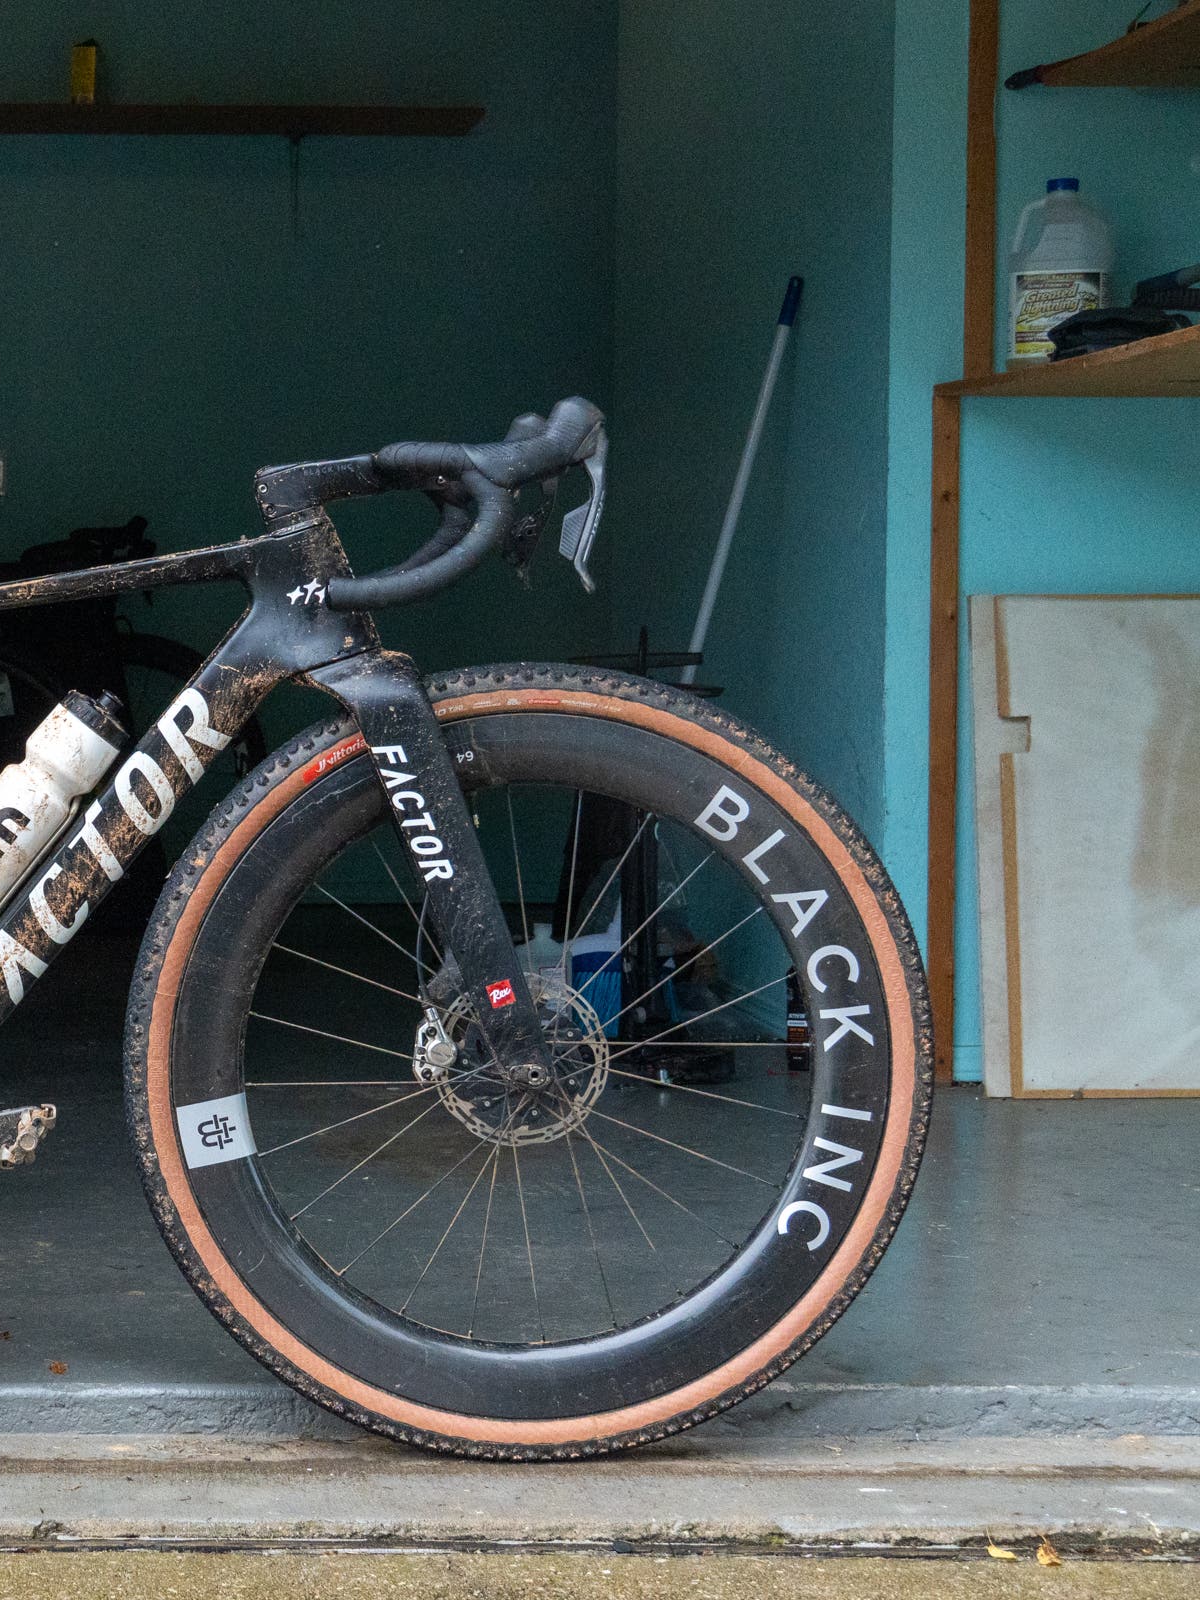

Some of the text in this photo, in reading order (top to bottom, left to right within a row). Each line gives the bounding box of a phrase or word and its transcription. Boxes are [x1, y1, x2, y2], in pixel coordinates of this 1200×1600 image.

[1025, 282, 1079, 302] Greased
[1021, 300, 1078, 317] Lightning
[324, 738, 366, 767] vittoria
[456, 750, 474, 763] 64
[370, 744, 454, 883] FACTOR
[489, 987, 511, 1004] Rex
[693, 784, 875, 1252] BLACK INC
